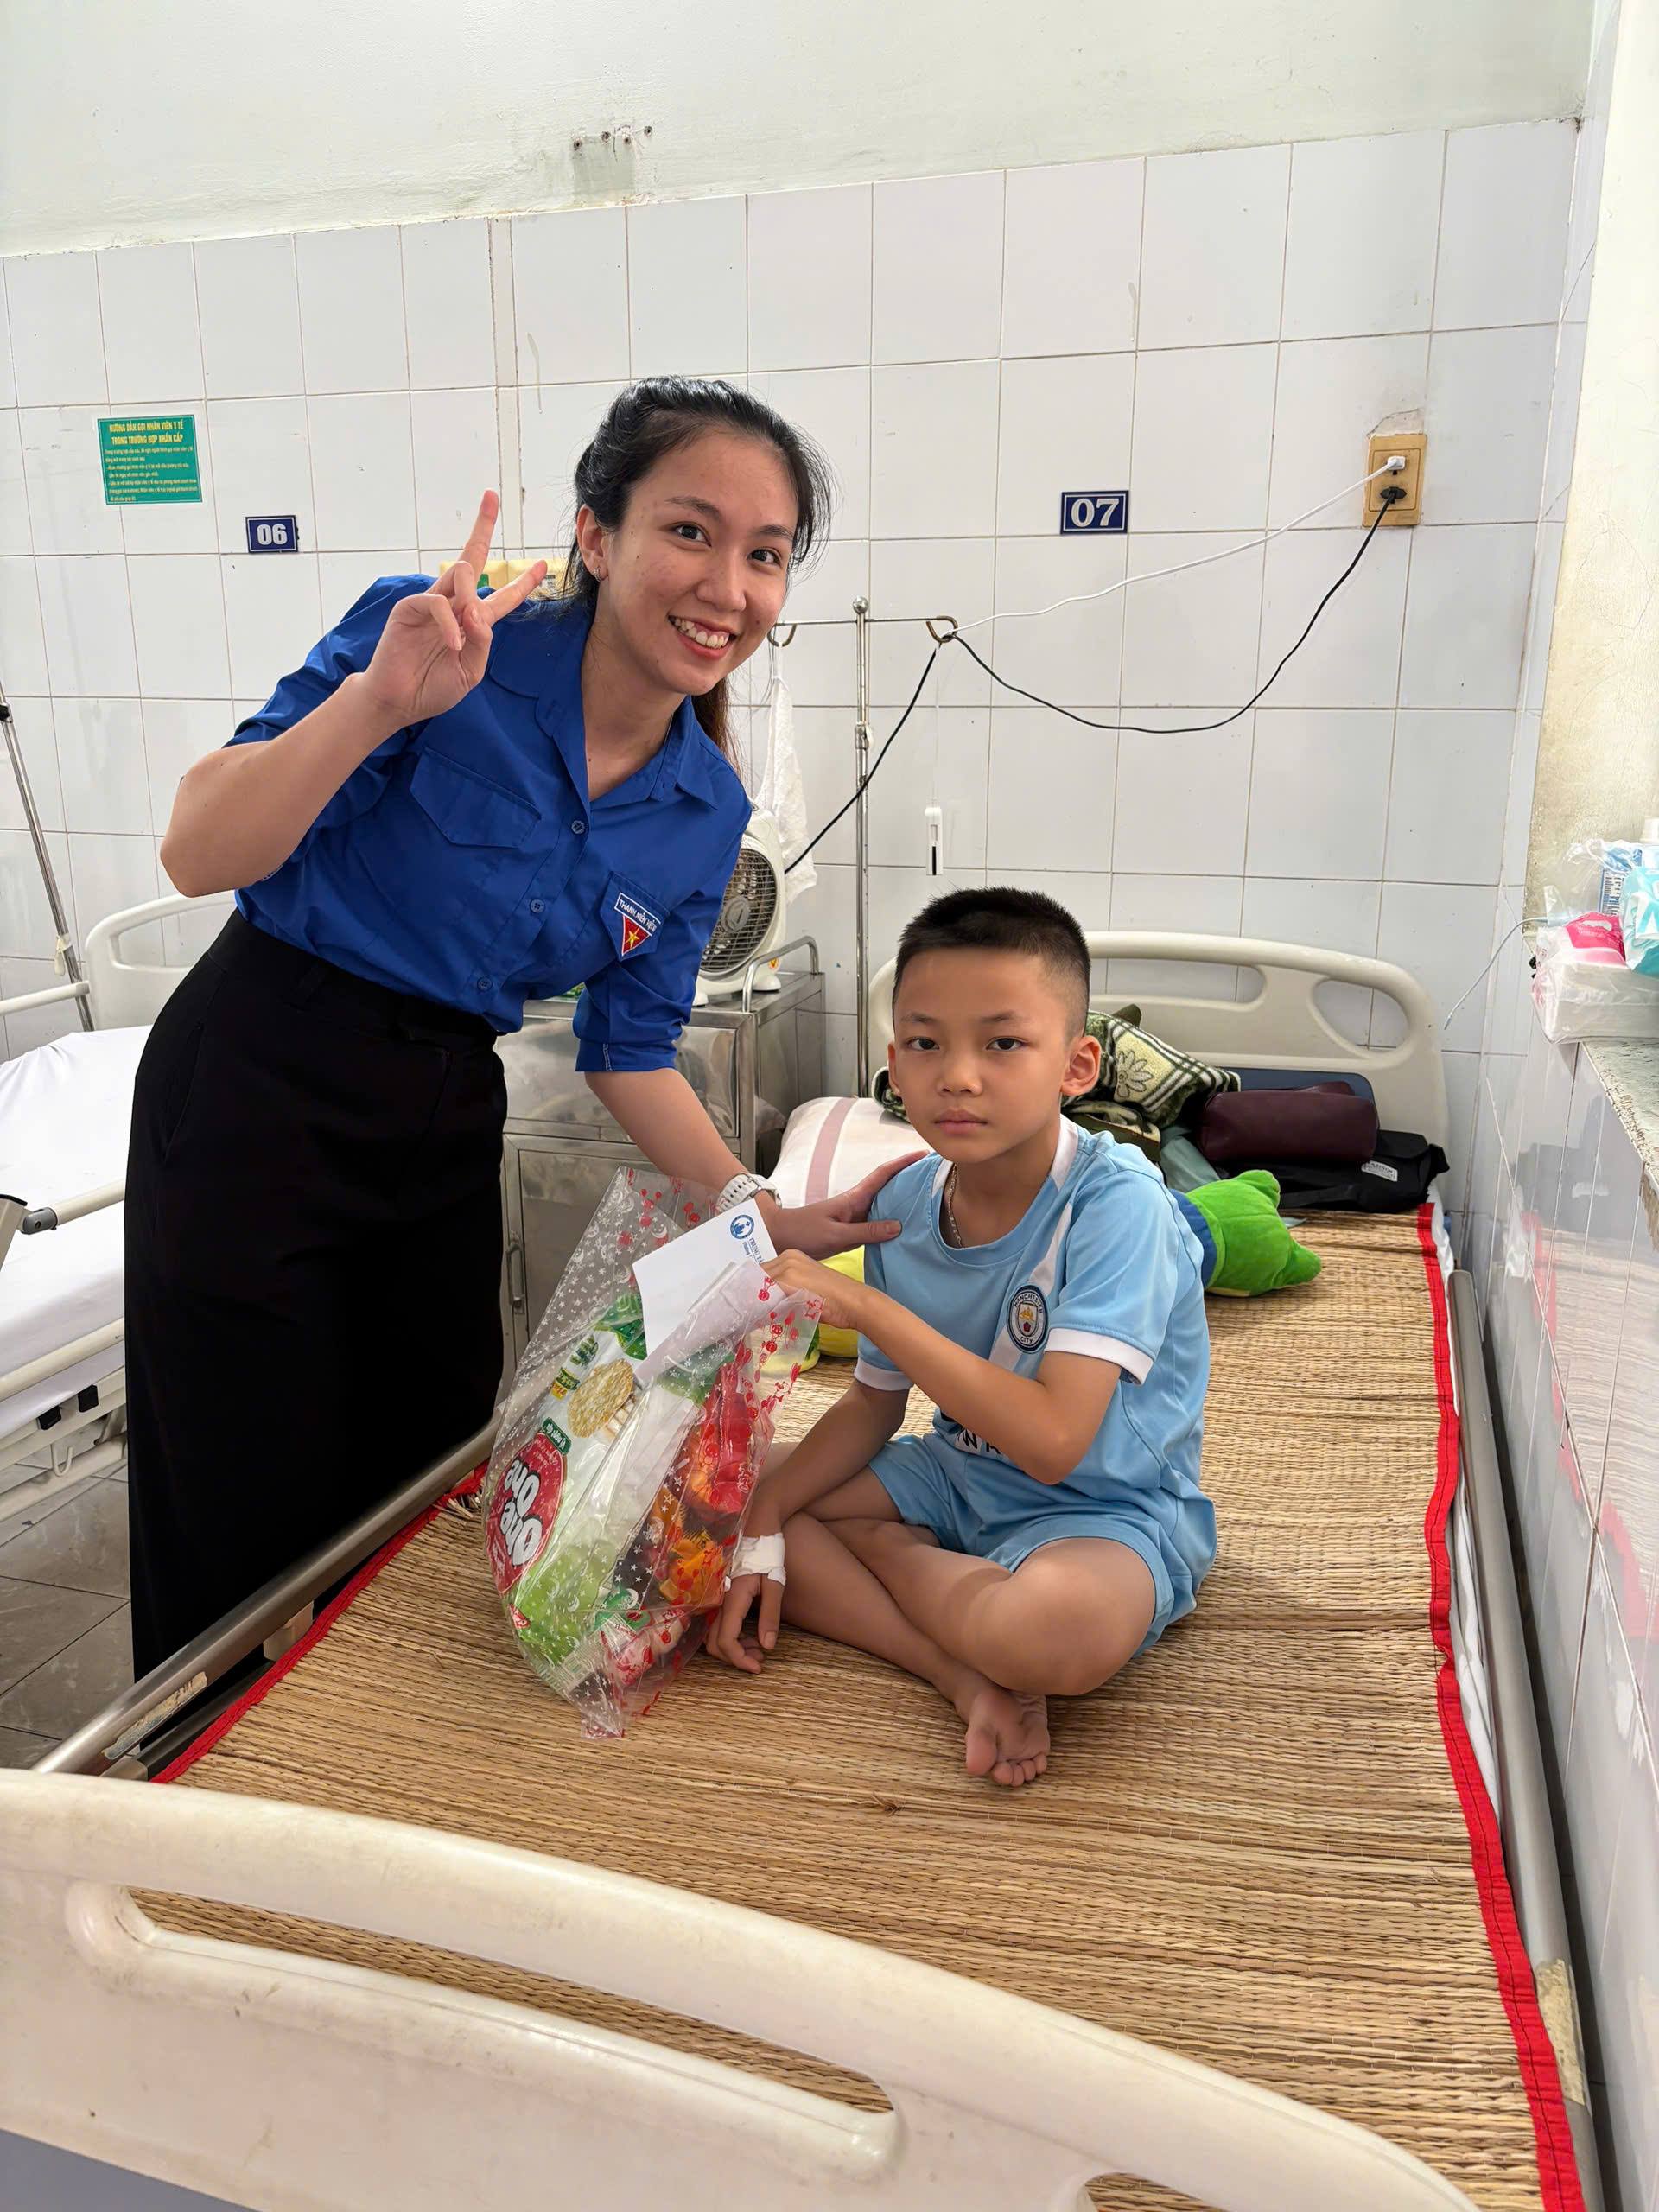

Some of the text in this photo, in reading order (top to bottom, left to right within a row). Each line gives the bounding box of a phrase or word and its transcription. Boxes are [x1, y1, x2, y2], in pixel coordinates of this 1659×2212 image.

[1071, 498, 1119, 527] 07
[257, 523, 288, 545] 06
[619, 899, 638, 915] THANH
[1014, 1294, 1043, 1314] MANCHESTER
[1020, 1336, 1033, 1344] CITY
[504, 1459, 541, 1519] One
[500, 1500, 542, 1567] One
